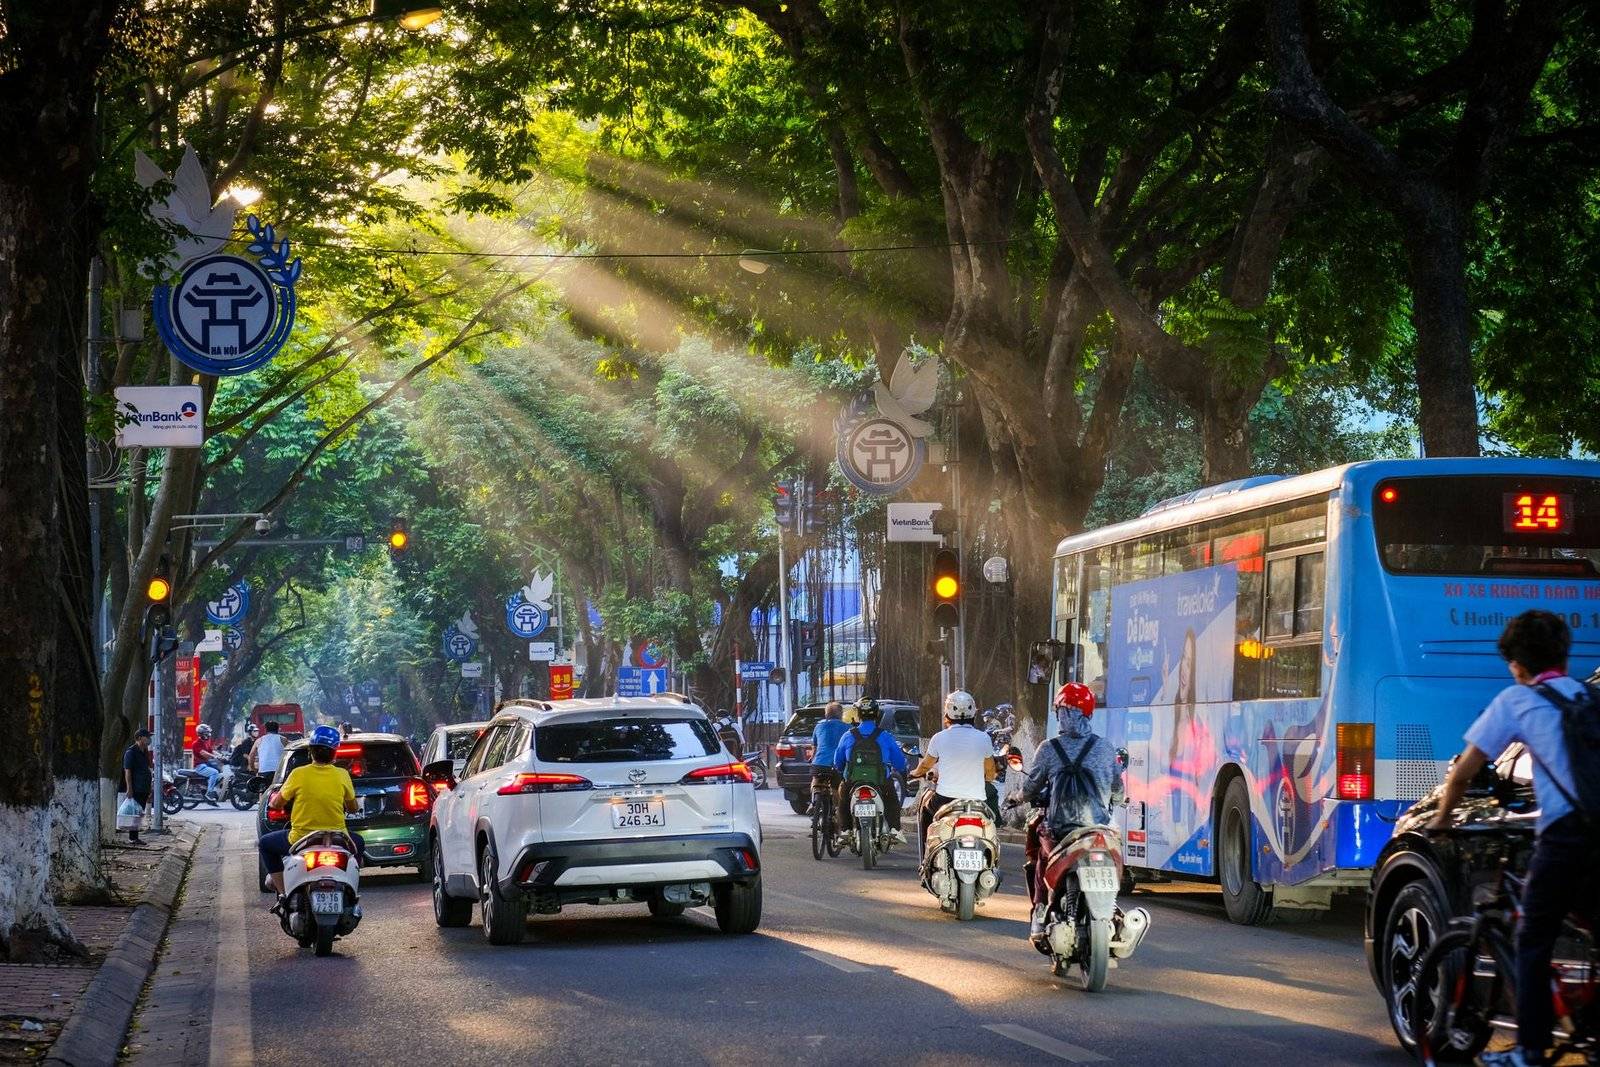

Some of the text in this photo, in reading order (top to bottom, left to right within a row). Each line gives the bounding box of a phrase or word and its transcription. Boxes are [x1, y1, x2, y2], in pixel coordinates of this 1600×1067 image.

[223, 345, 239, 356] NỘI
[1515, 495, 1559, 527] 14
[891, 518, 930, 526] VietinBank
[626, 803, 649, 814] 30H
[619, 814, 659, 827] 246.34
[1087, 878, 1114, 889] 1139
